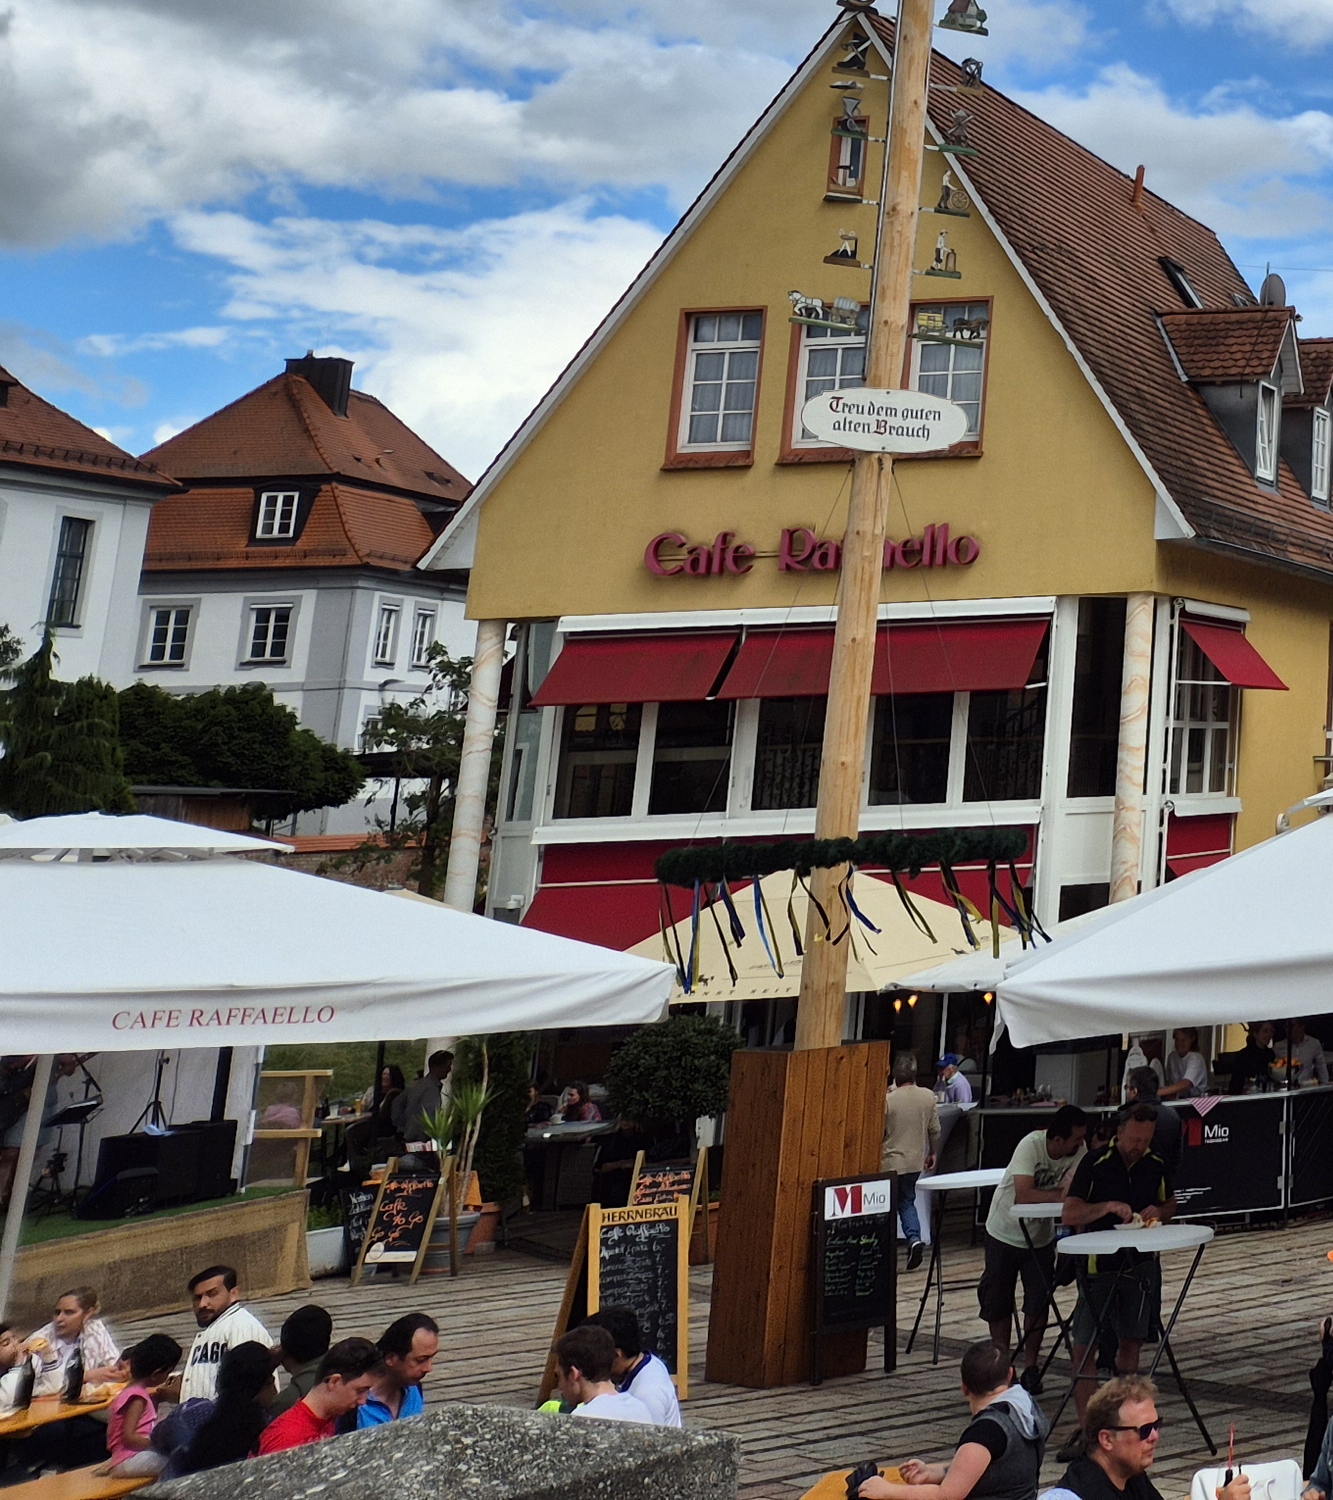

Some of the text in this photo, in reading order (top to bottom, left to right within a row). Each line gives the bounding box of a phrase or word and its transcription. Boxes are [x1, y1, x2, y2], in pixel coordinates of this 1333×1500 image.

[829, 395, 941, 422] Treu dem guten
[832, 417, 930, 441] alten Brauch
[644, 522, 981, 576] Cafe Raello
[112, 1005, 335, 1030] CAFE RAFFAELLO
[1204, 1124, 1229, 1139] Mio
[863, 1192, 886, 1205] Mio
